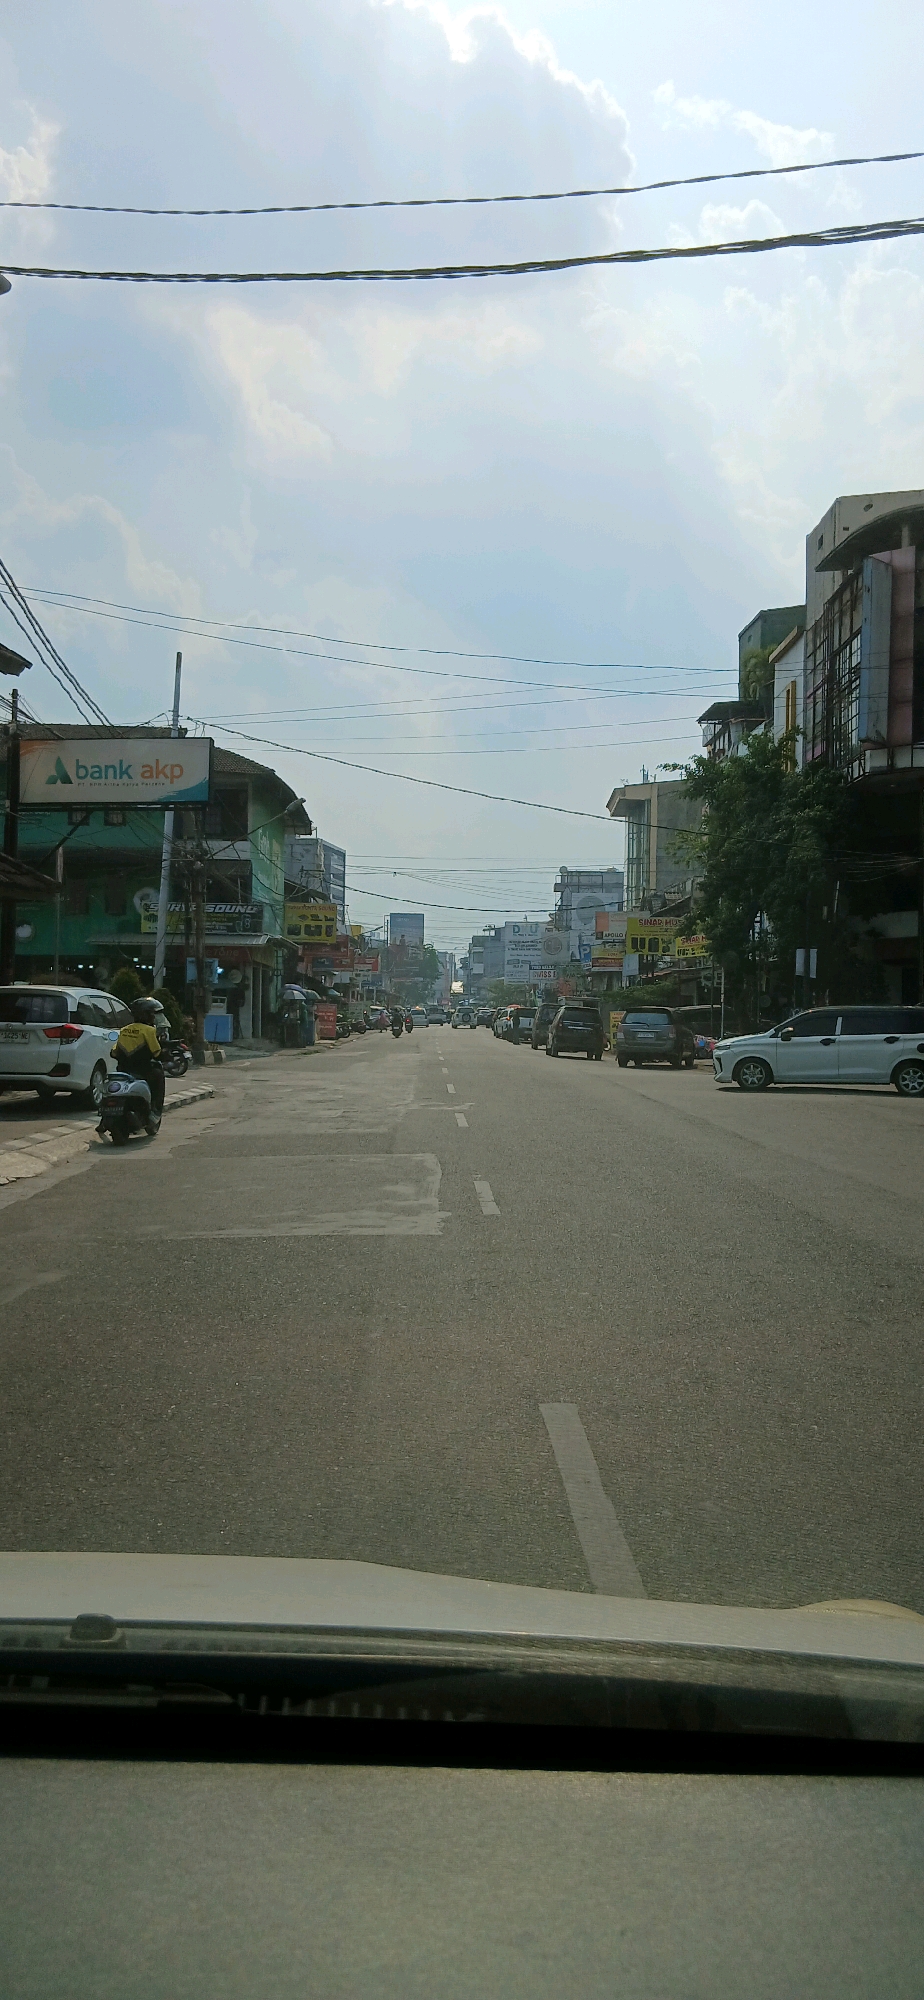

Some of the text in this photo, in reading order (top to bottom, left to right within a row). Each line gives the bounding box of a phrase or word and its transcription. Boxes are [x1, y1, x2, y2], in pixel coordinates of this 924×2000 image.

[75, 759, 184, 784] bank akp
[204, 903, 257, 913] SOUND
[638, 918, 664, 927] SINAR
